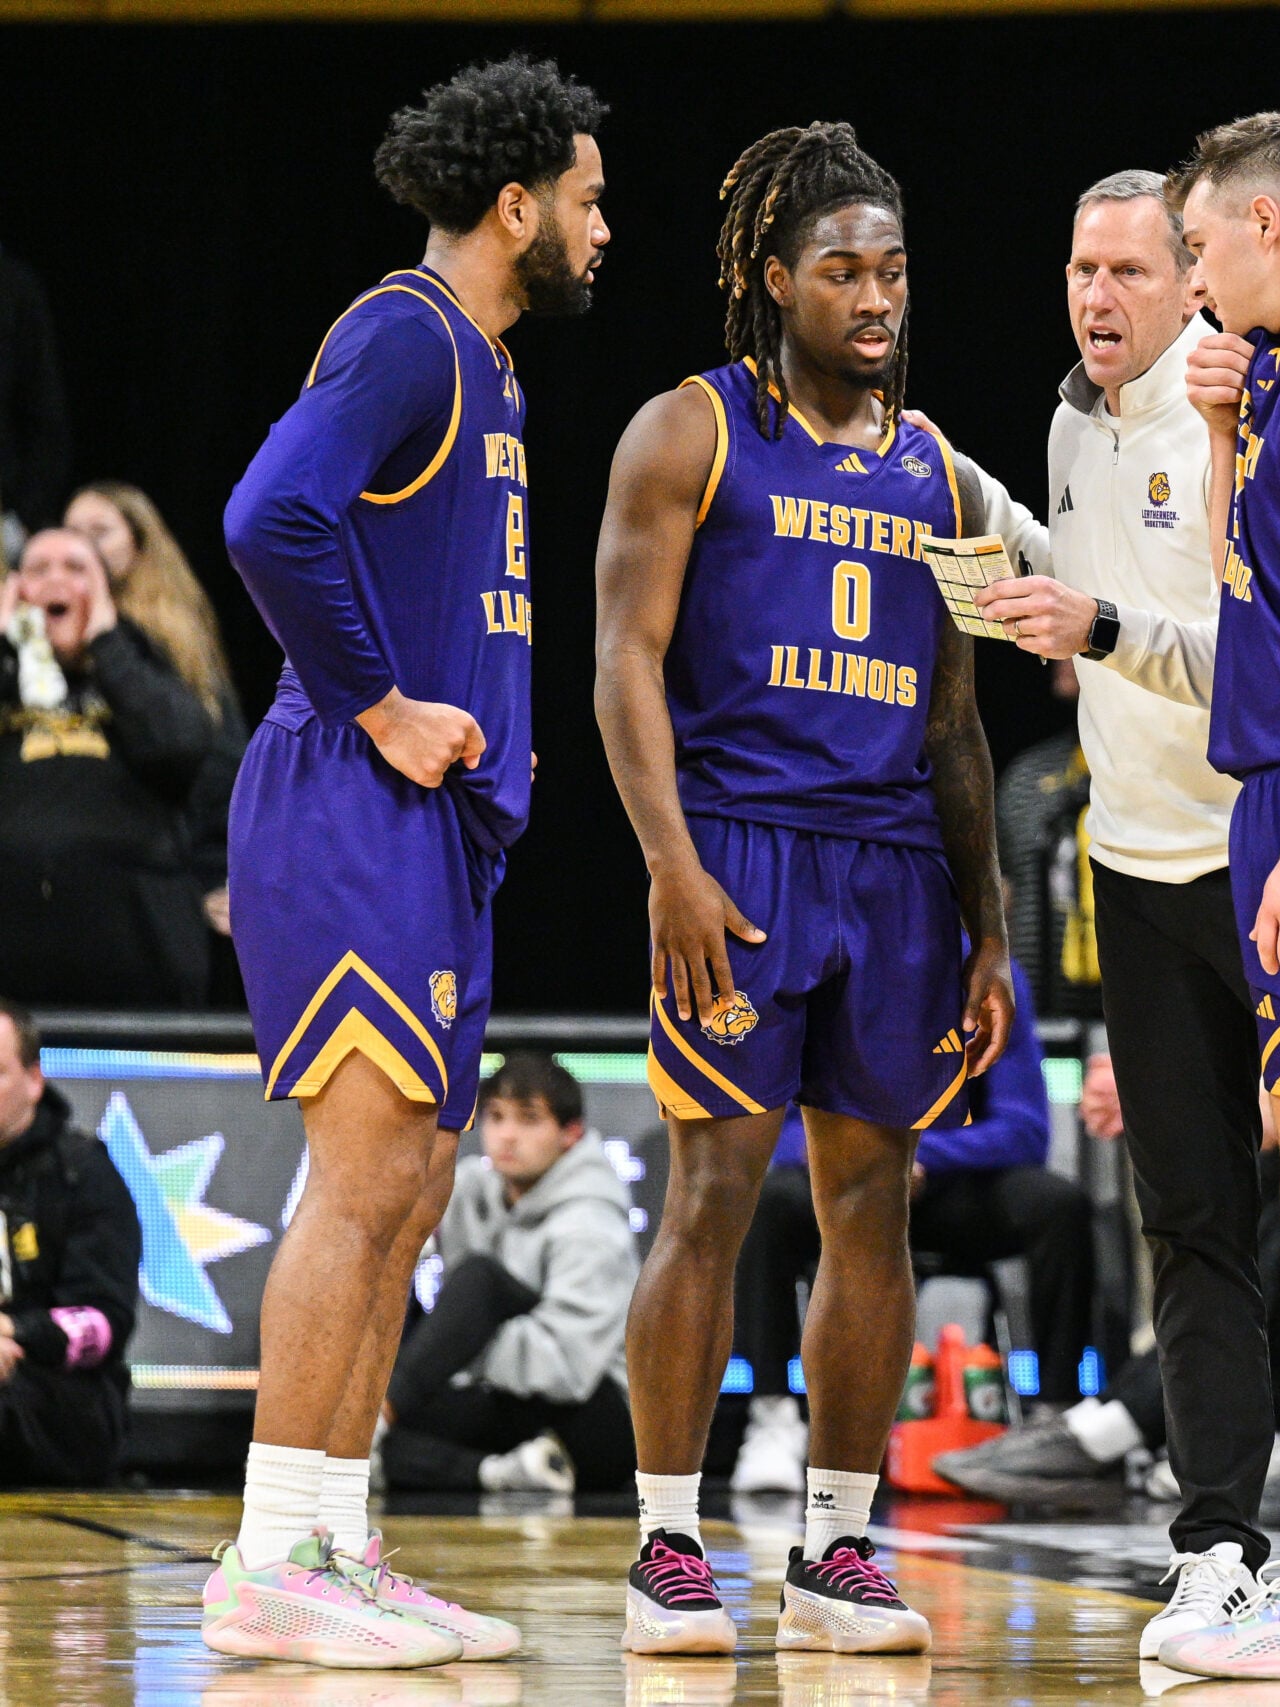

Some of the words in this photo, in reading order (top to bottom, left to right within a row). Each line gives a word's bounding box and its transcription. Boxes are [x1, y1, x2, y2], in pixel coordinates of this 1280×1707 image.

[769, 494, 932, 563] WESTERN
[832, 560, 871, 641] 0
[767, 645, 917, 707] ILLINOIS
